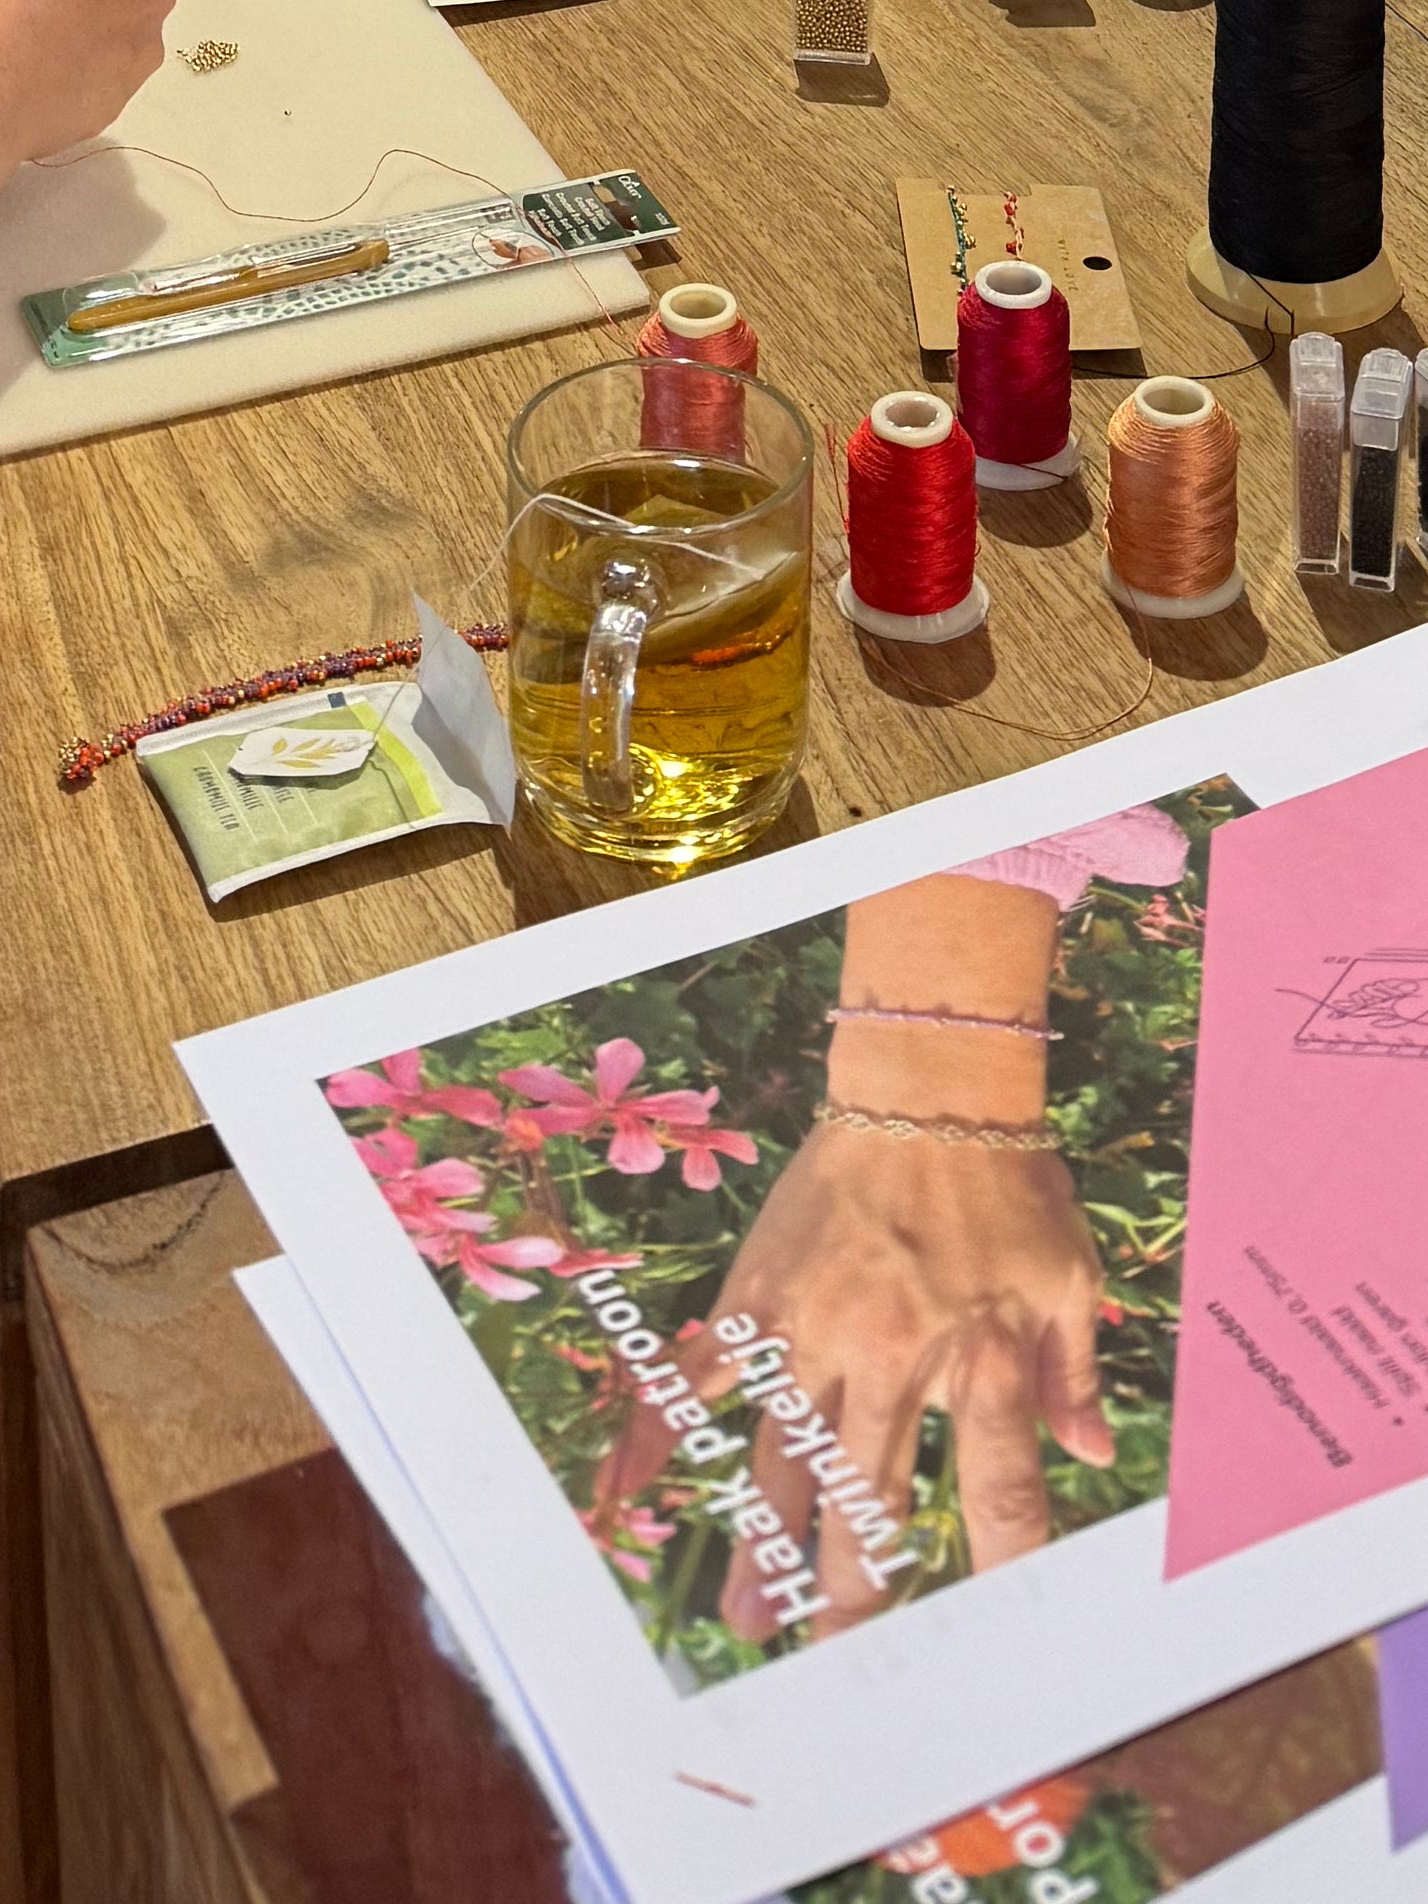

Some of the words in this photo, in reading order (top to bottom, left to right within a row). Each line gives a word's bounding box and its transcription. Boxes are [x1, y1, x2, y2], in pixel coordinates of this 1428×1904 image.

[575, 1269, 749, 1465] patroon
[1206, 1301, 1353, 1468] Benodigdheden
[1355, 1282, 1408, 1332] garen
[714, 1311, 921, 1590] Twinkeltje
[705, 1466, 832, 1627] Haak
